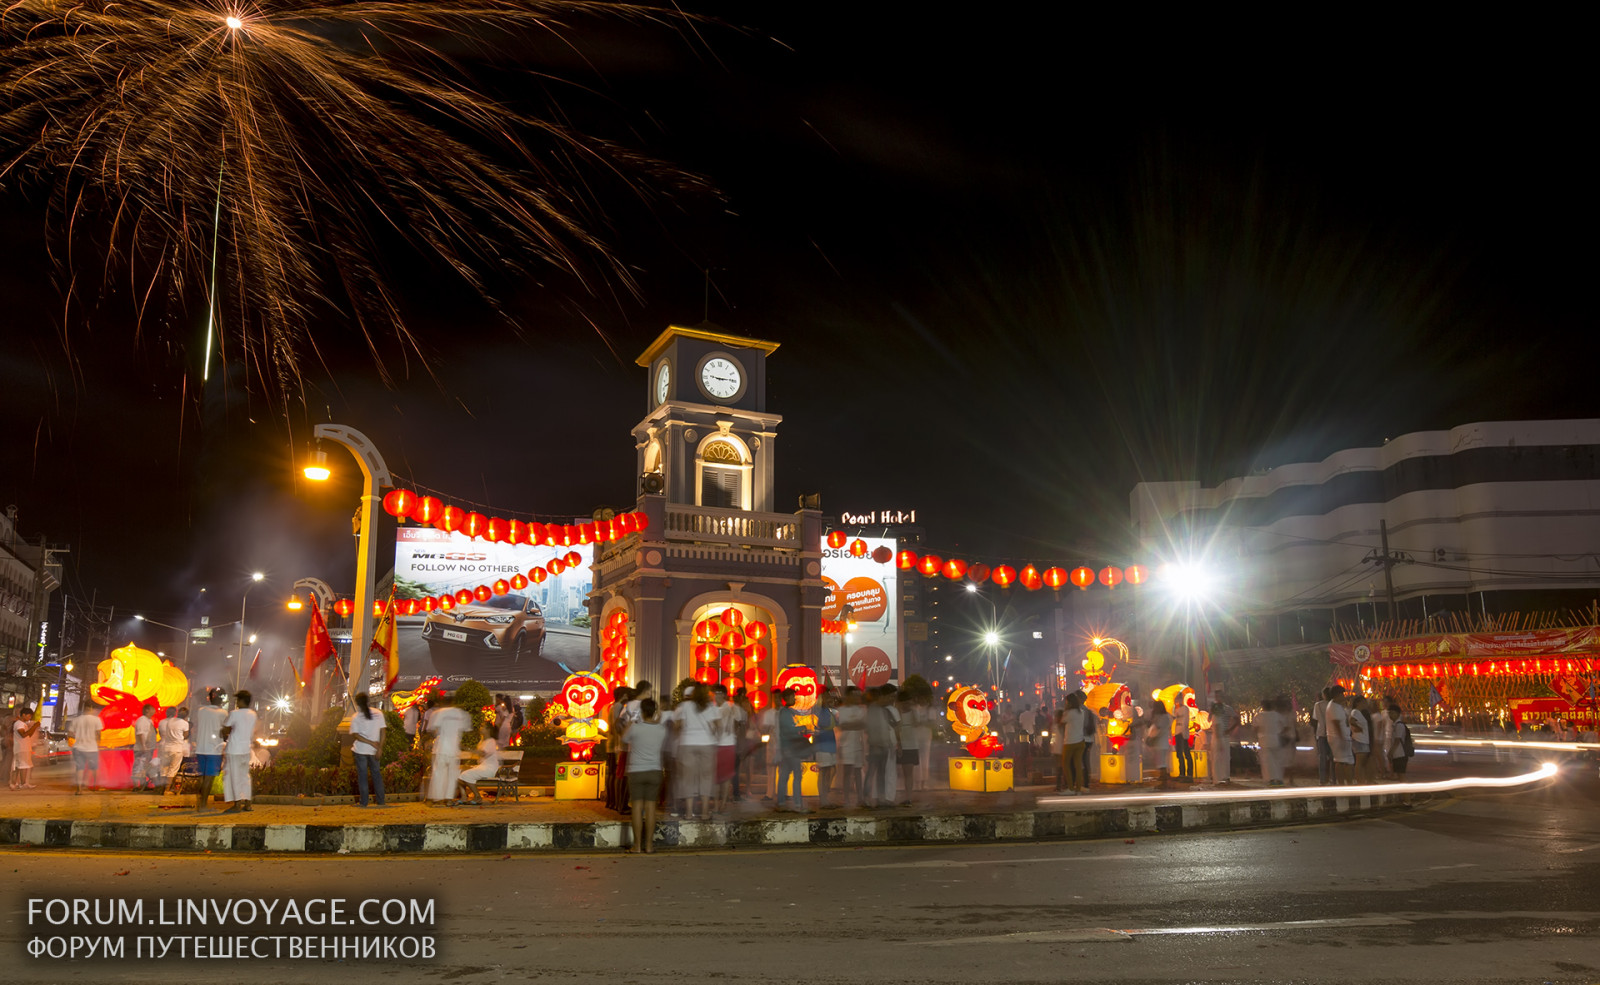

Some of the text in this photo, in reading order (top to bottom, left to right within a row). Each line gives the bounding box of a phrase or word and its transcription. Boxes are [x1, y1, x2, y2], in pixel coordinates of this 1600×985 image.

[841, 510, 916, 525] Pearl Hotel
[411, 563, 520, 573] FOLLOW NO OTHERS
